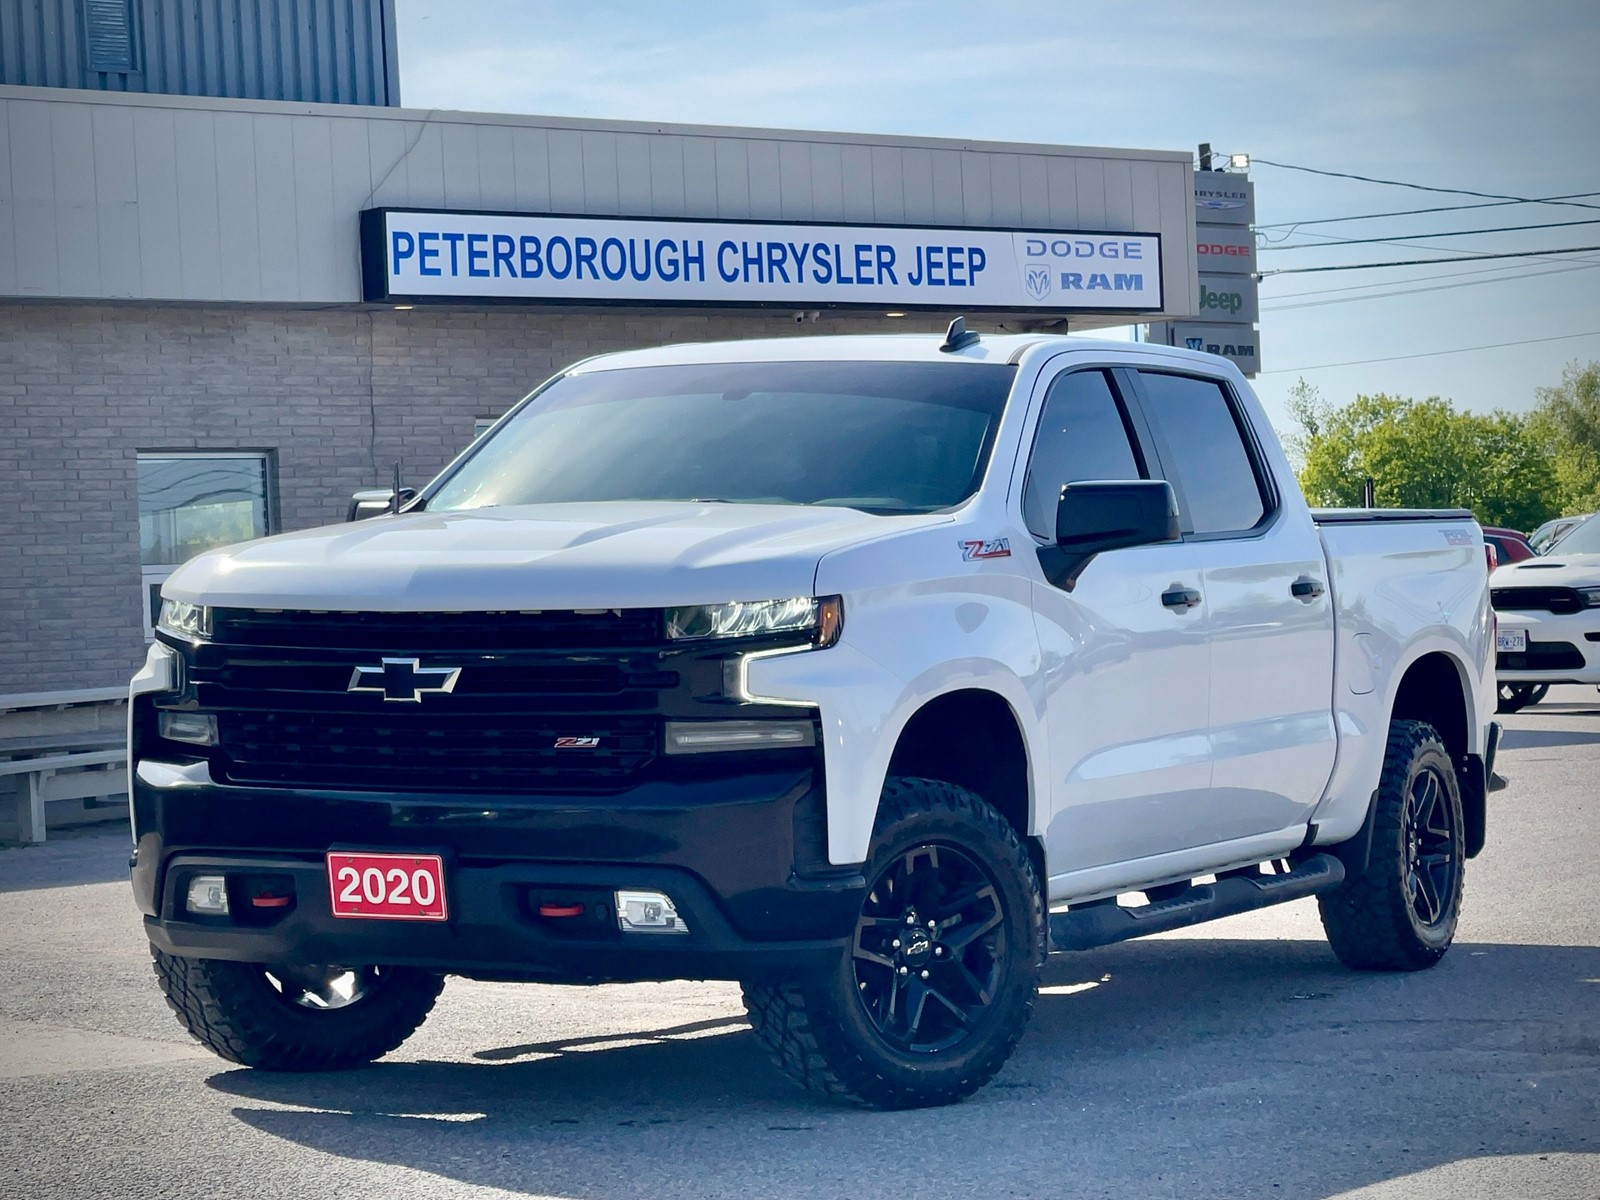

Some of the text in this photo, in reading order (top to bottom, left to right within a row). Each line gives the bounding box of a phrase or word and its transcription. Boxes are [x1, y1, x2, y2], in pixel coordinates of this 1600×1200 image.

[1195, 190, 1247, 199] RYSLER
[391, 230, 986, 287] PETERBOROUGH CHRYSLER JEEP
[1026, 239, 1143, 260] DODGE
[1197, 243, 1251, 257] ODGE
[1060, 272, 1144, 291] RAM
[1199, 284, 1243, 315] Jeep
[1206, 344, 1255, 357] RAM
[958, 537, 1012, 562] Z71
[554, 736, 600, 748] Z71
[337, 866, 436, 906] 2020
